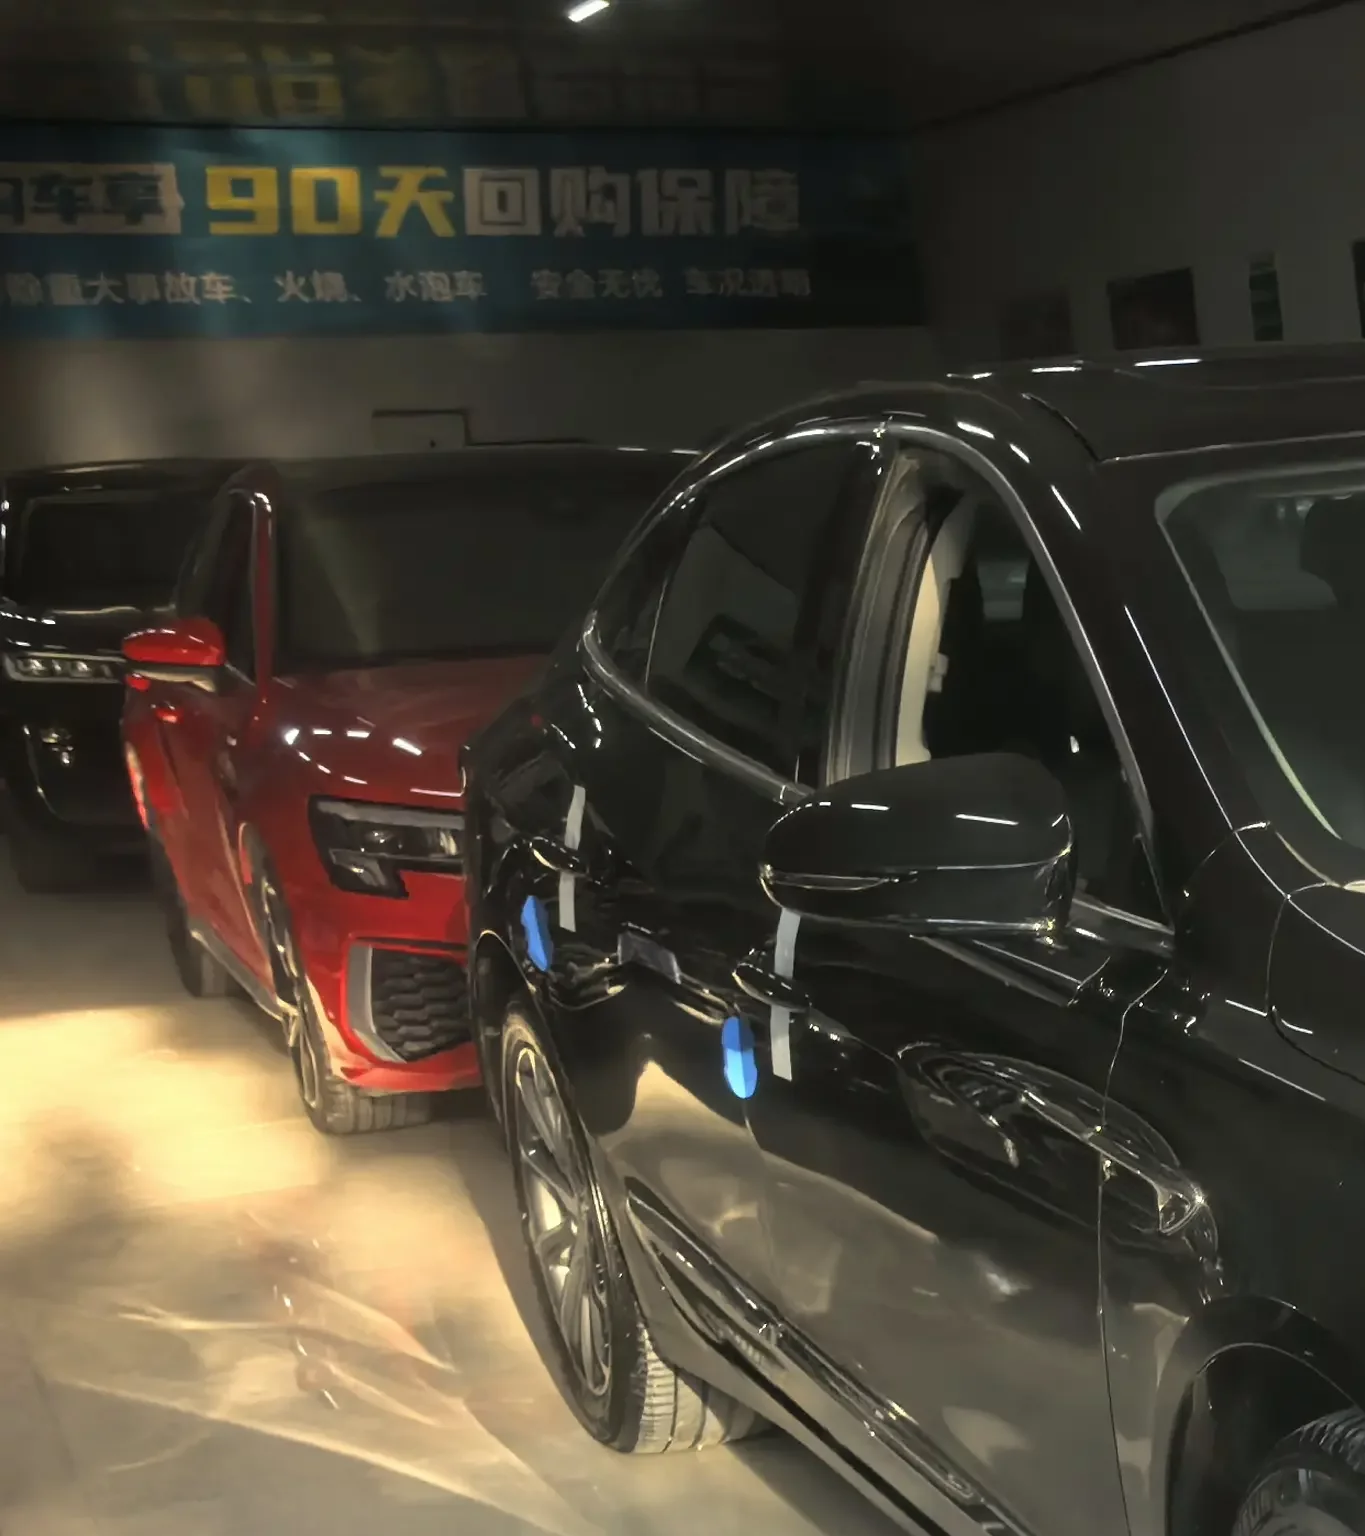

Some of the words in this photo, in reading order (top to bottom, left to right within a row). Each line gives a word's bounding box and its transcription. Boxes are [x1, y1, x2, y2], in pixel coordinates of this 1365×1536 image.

[204, 165, 800, 238] 90天回购保障
